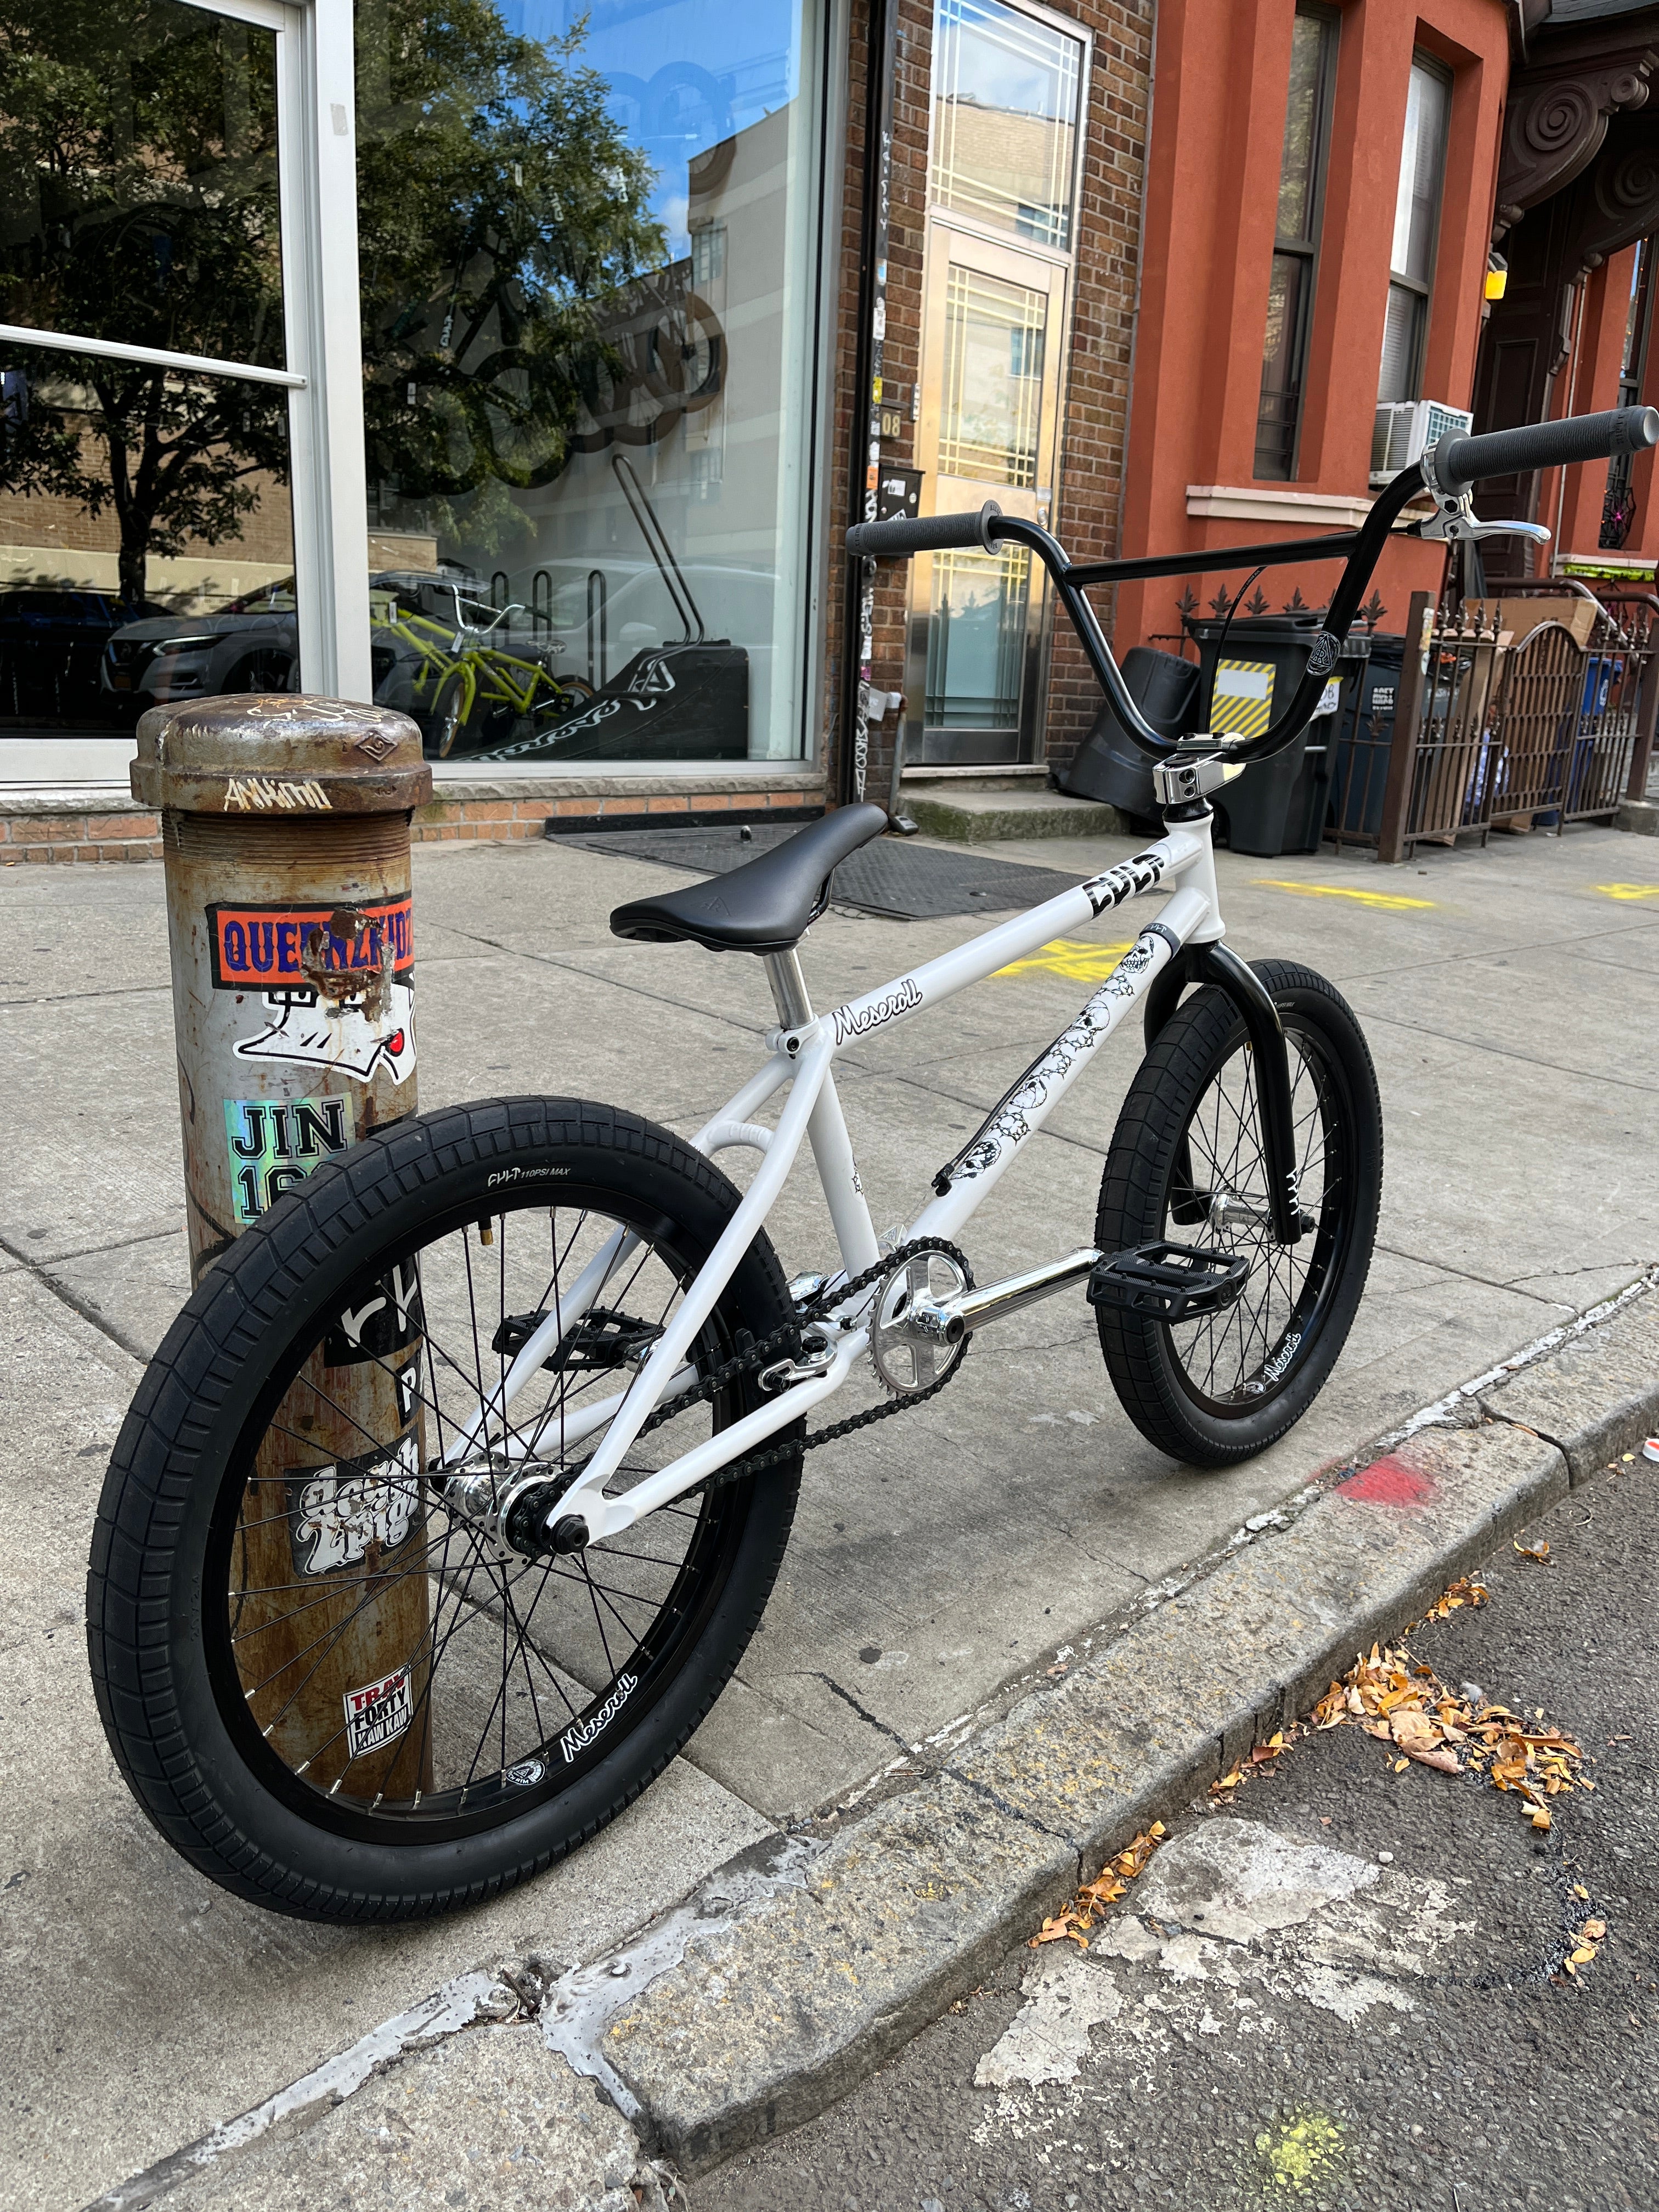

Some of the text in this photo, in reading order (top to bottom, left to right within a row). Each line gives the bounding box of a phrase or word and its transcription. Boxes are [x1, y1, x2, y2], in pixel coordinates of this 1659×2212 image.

[1082, 854, 1164, 919] CULT
[1145, 924, 1167, 933] CULT
[832, 979, 923, 1046] Meseroll
[231, 1099, 348, 1160] JIN
[238, 1161, 331, 1219] 16
[488, 1167, 521, 1187] CULT
[521, 1168, 550, 1179] 110PSI
[354, 1685, 406, 1731] FORTY
[358, 1707, 407, 1748] KAW KAW
[560, 1673, 638, 1763] Meseroll
